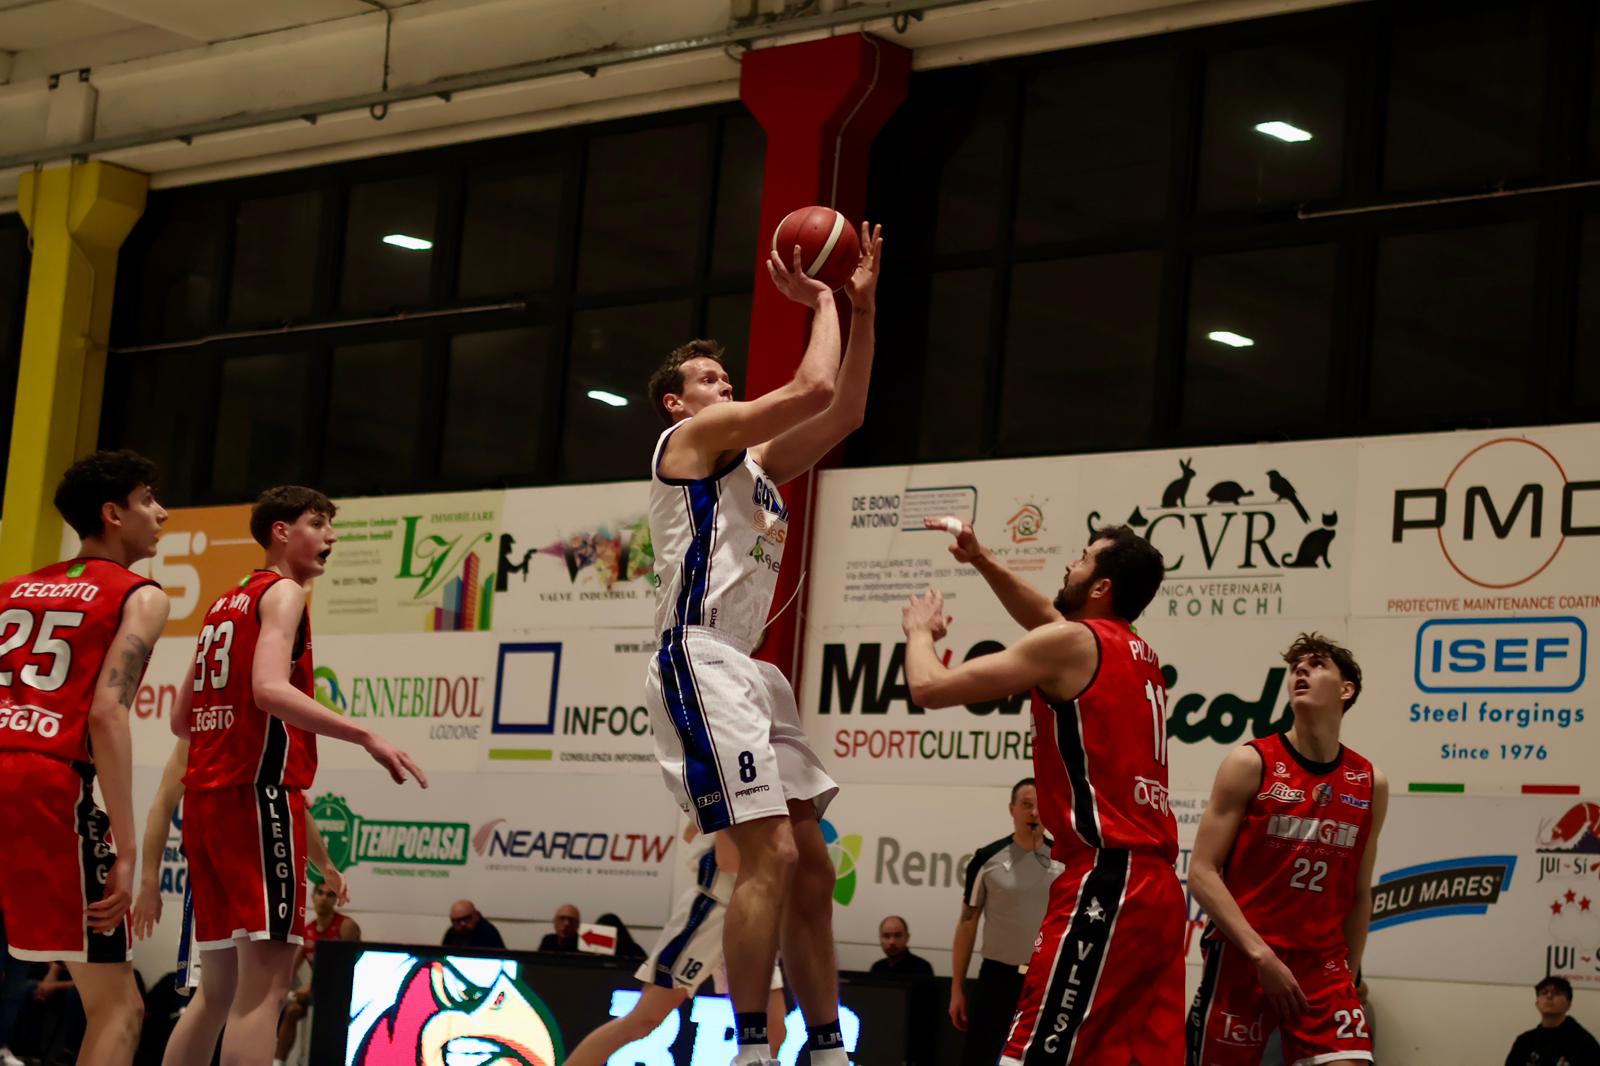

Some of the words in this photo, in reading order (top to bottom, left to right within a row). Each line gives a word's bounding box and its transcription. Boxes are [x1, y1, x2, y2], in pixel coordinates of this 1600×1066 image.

[852, 496, 866, 511] DE
[869, 495, 900, 511] BONO
[431, 511, 495, 523] IMMOBILIARE
[851, 513, 899, 529] ANTONIO
[1144, 510, 1281, 571] CVR
[10, 582, 100, 602] CECCATO
[540, 592, 573, 602] VALVE
[579, 590, 637, 601] INDUSTRIAL
[1199, 582, 1283, 596] VETERINARIA
[1168, 597, 1283, 616] RONCHI
[1387, 599, 1459, 613] PROTECTIVE
[1463, 597, 1555, 611] MAINTENANCE
[0, 608, 85, 692] 25
[193, 620, 234, 692] 33
[1432, 637, 1570, 673] ISEF
[350, 676, 484, 718] ENNEBIDOL
[1409, 702, 1468, 722] Steel
[1479, 702, 1585, 728] forgings
[429, 725, 480, 740] LOZIONE
[1441, 744, 1489, 759] Since
[1500, 745, 1548, 760] 1976
[738, 751, 757, 783] 8
[735, 784, 770, 799] PRIMATO
[1257, 782, 1306, 802] Laica
[265, 784, 288, 920] OLEGGIO
[359, 825, 465, 861] TEMPOCASA
[489, 830, 608, 860] NEARCO
[609, 834, 675, 863] LTW
[1290, 858, 1328, 892] 22
[1372, 884, 1414, 915] BLU
[1418, 874, 1495, 903] MARES
[680, 957, 703, 980] 18
[1334, 1008, 1370, 1039] 22
